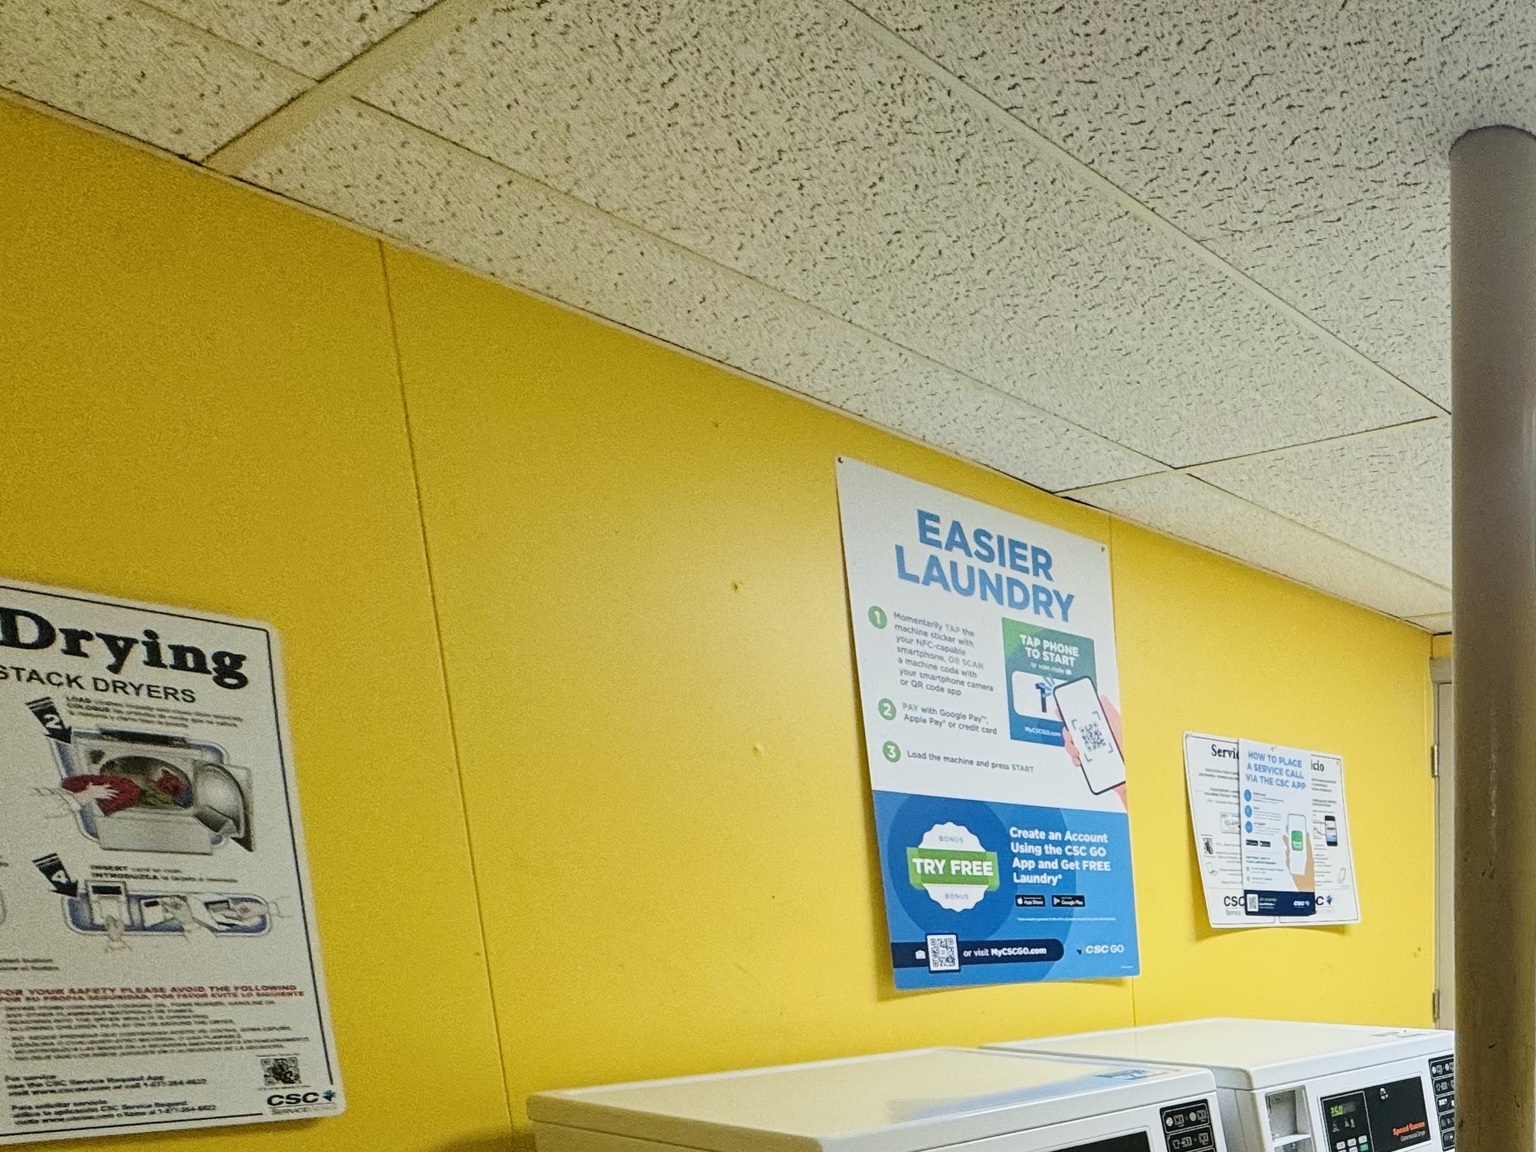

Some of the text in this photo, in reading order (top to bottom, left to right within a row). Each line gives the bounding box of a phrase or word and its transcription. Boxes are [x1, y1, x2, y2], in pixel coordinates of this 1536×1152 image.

[916, 508, 1054, 582] EASIER
[895, 544, 1075, 623] LAUNDRY
[873, 610, 882, 625] 1
[893, 611, 942, 631] Momentarily
[962, 628, 975, 638] the
[895, 624, 974, 648] machine sticker with
[0, 606, 248, 689] Drying
[896, 635, 966, 656] your NFC-capable
[1019, 634, 1080, 658] TAP PHONE
[897, 646, 947, 663] smartphone,
[962, 658, 984, 670] SCAN
[1025, 646, 1076, 667] TO START
[905, 658, 938, 671] machine
[961, 669, 977, 678] with
[899, 668, 994, 692] your smartphone camera
[910, 679, 924, 689] QR
[925, 683, 945, 693] code
[947, 687, 962, 696] app
[92, 676, 196, 703] DRYERS
[883, 702, 967, 721] 2 PAY with Google
[44, 714, 61, 729] 2
[903, 713, 998, 735] Apple or credit card
[887, 744, 1034, 773] 3 Load the machine and press START
[1248, 751, 1302, 768] HOW TO PLACE
[1246, 762, 1305, 779] A SERVICE CALL
[1245, 773, 1258, 783] VIA
[1260, 775, 1274, 786] THE
[1275, 778, 1290, 788] CSC
[1291, 781, 1306, 790] APP
[939, 835, 964, 843] BONUS
[1009, 826, 1109, 843] Create an Account
[1010, 841, 1107, 858] Using the CSC GO
[911, 858, 994, 876] TRY FREE
[1012, 857, 1112, 872] App and Get FREE
[973, 948, 990, 957] visit
[991, 947, 1047, 957] MyCSCGO.com
[1084, 944, 1125, 954] CSC GO
[120, 986, 166, 994] PLEASE
[267, 1091, 320, 1107] CSC
